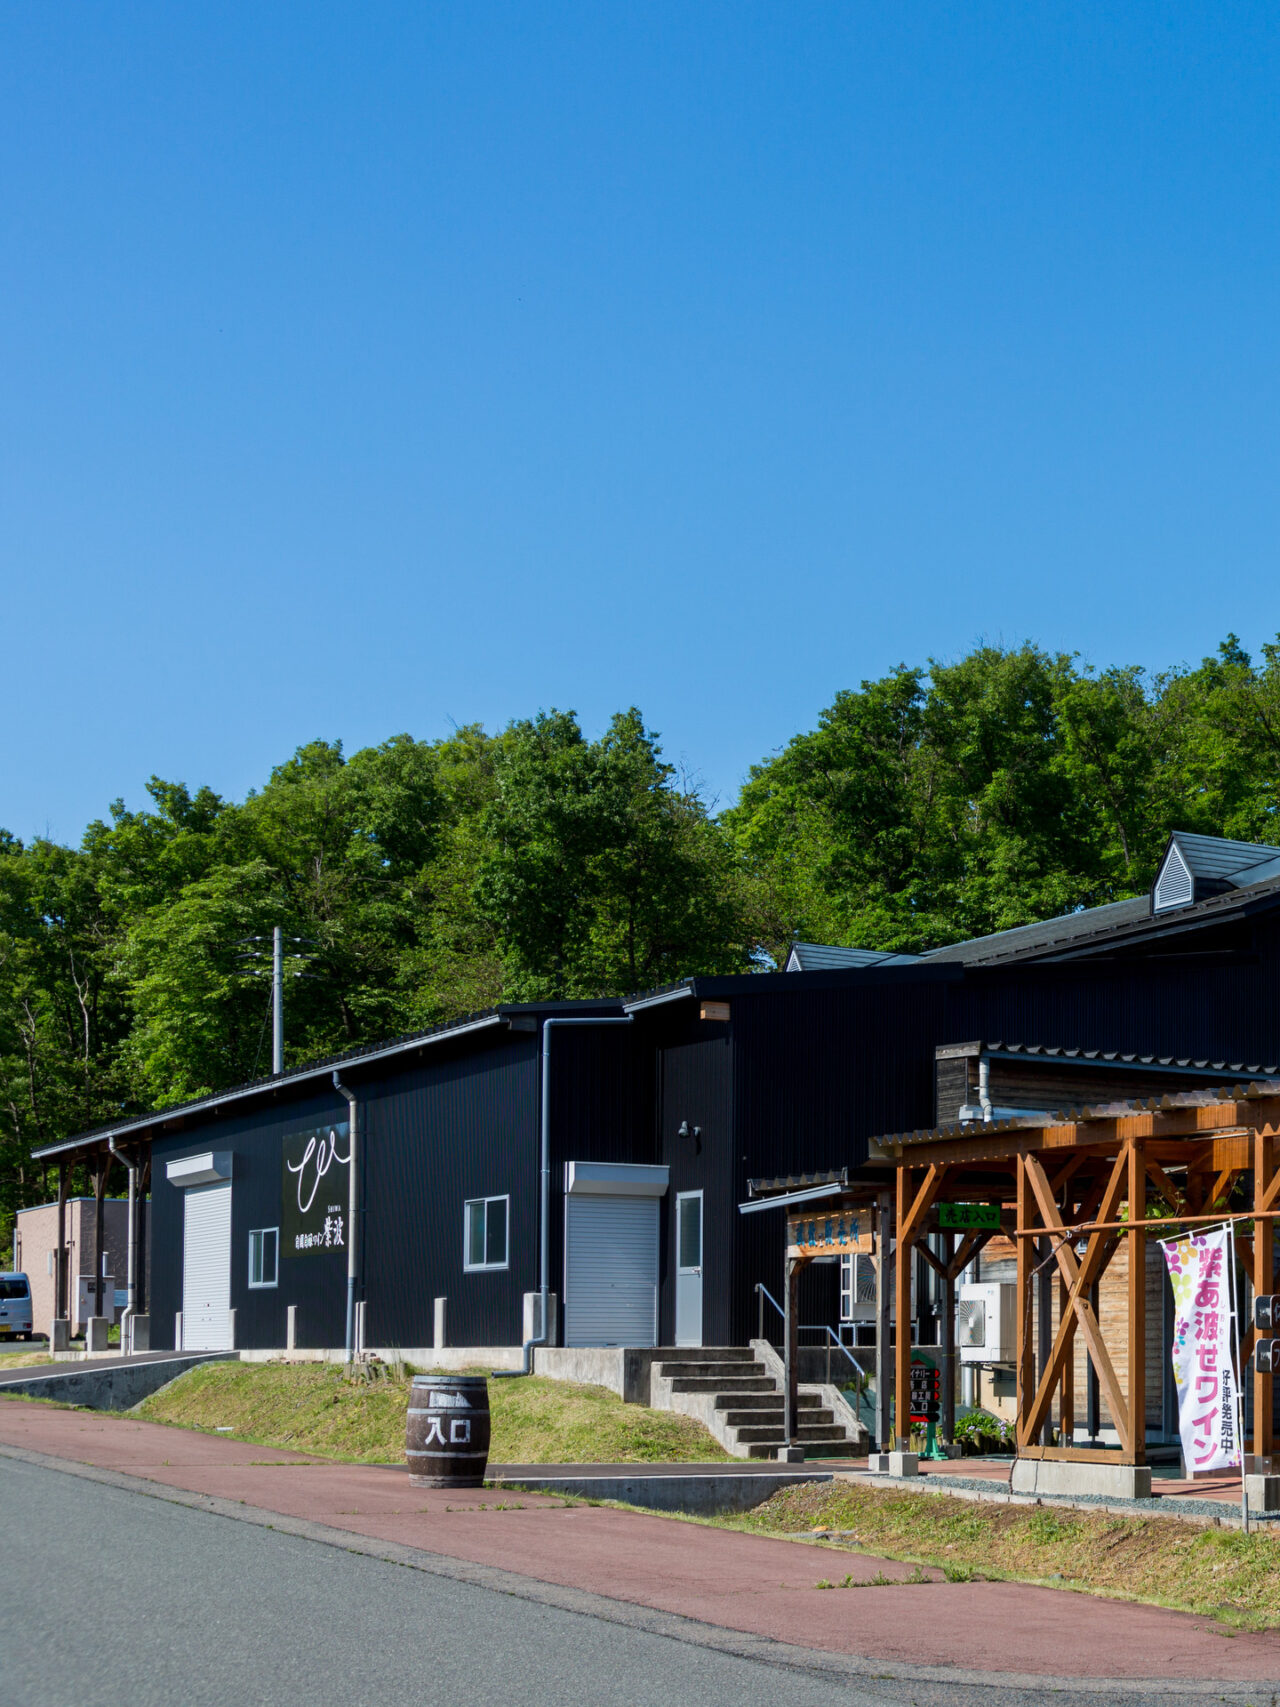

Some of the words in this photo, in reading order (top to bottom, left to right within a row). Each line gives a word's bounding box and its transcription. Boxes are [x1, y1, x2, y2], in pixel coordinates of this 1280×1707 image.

[945, 1207, 997, 1224] 売店入口
[911, 1369, 930, 1378] イナリー
[1221, 1369, 1234, 1454] 好評発売中
[425, 1416, 471, 1446] 入口
